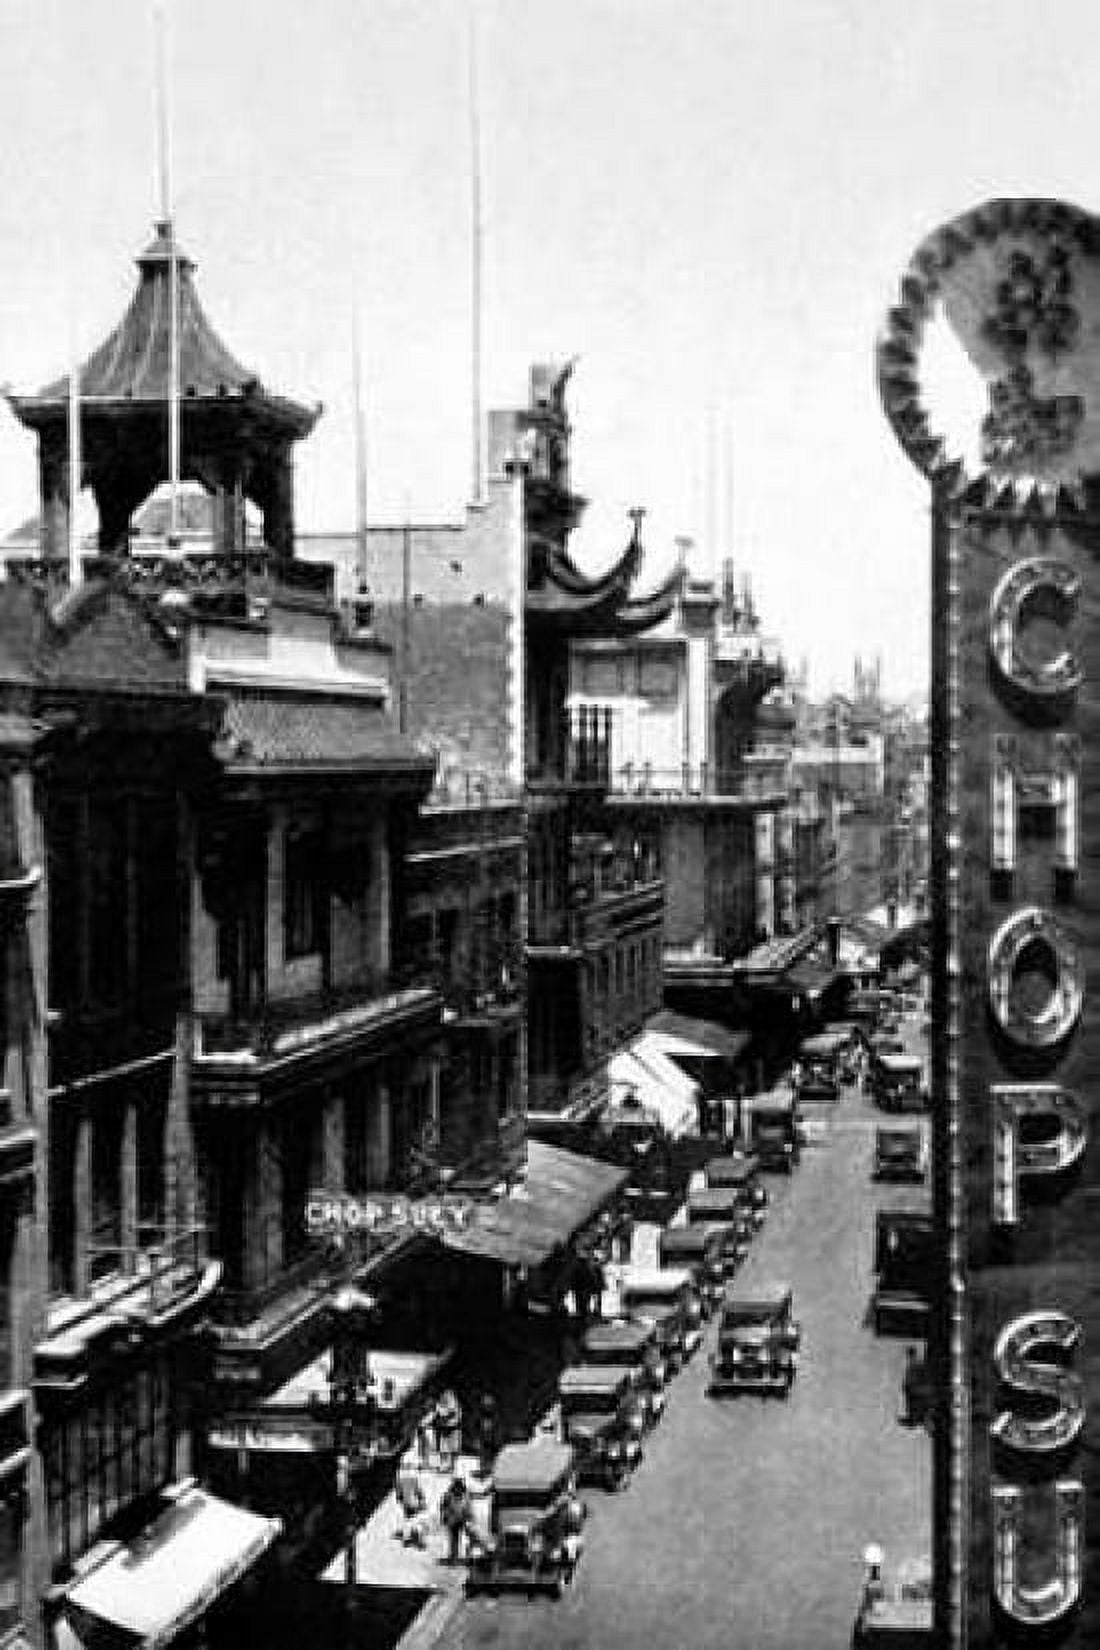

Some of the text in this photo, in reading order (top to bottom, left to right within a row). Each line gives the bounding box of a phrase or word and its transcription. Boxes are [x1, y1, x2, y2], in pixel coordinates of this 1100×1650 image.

[991, 556, 1086, 1224] CHOP
[304, 1200, 385, 1229] CHOP
[990, 1312, 1085, 1624] SU
